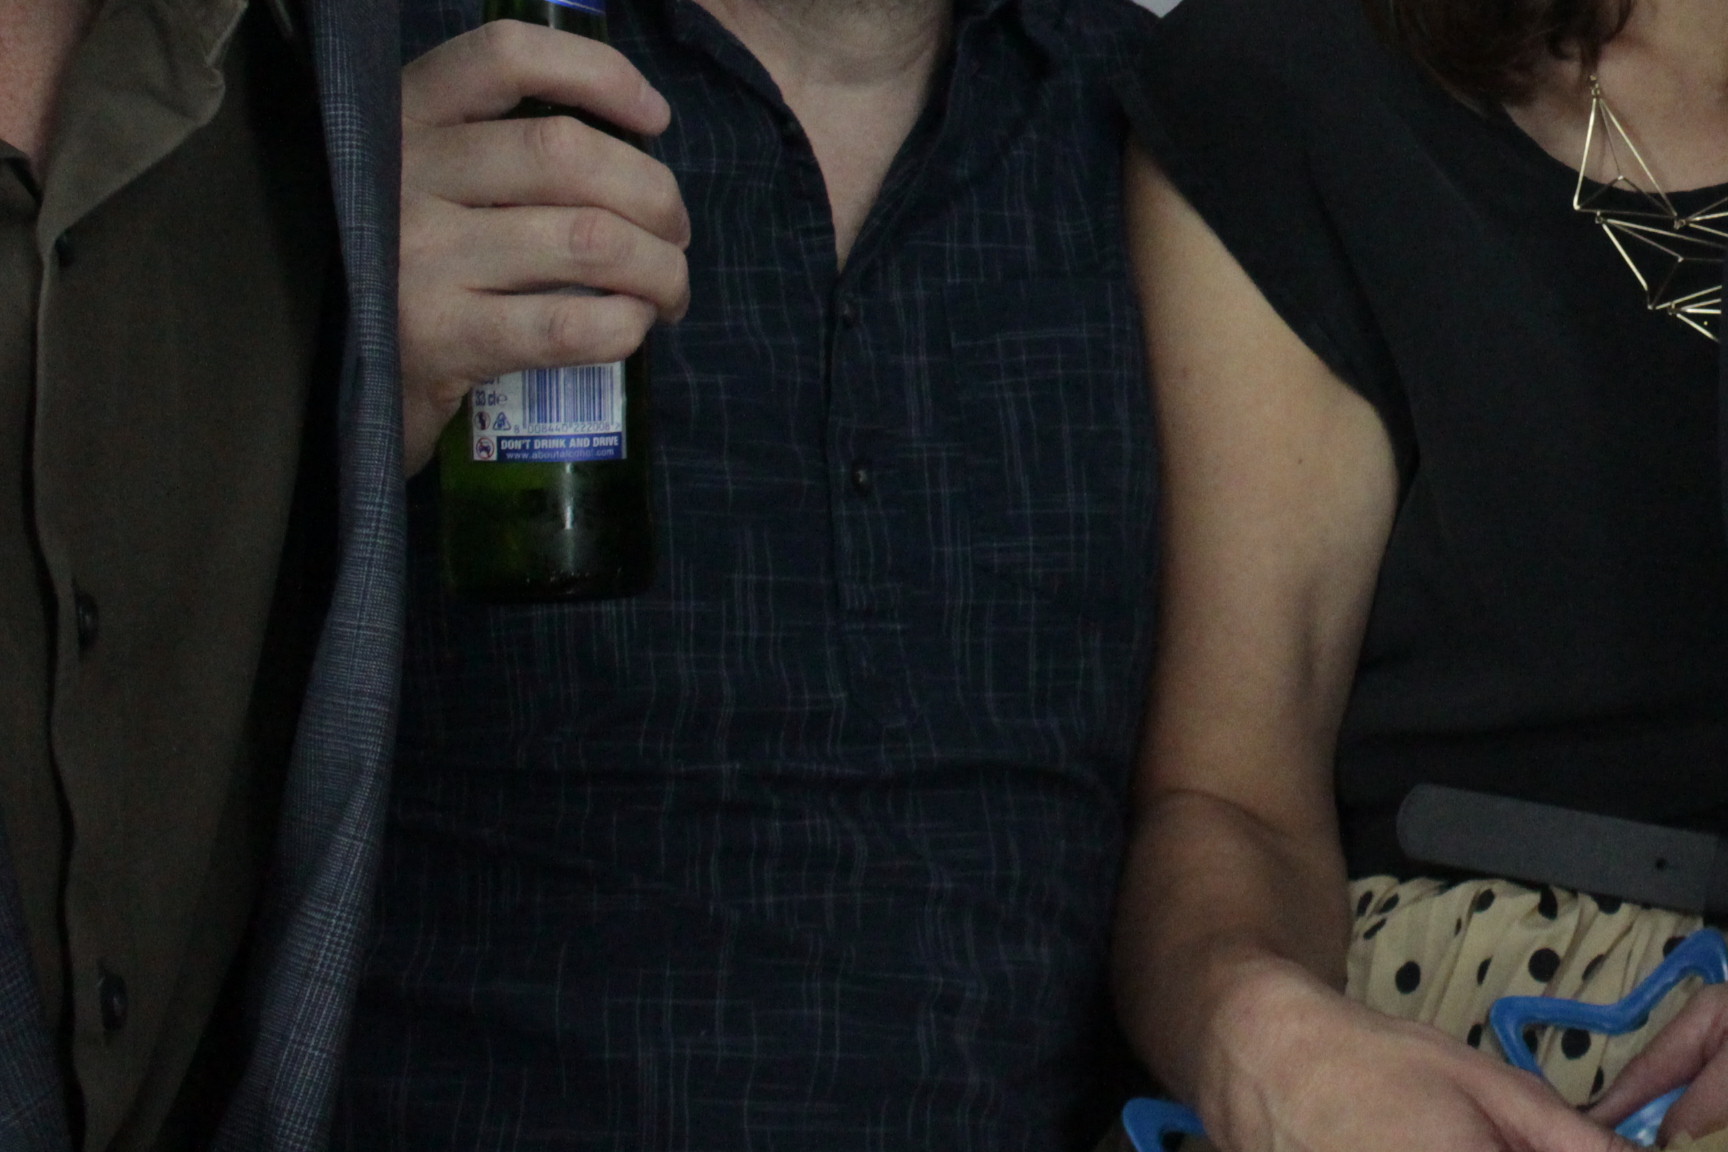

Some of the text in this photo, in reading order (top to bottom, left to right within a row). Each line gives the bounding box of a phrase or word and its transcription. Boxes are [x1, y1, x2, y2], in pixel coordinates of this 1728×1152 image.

[475, 390, 486, 406] 33
[487, 390, 496, 406] cl
[500, 435, 619, 450] DON'T DRINK AND DRIVE
